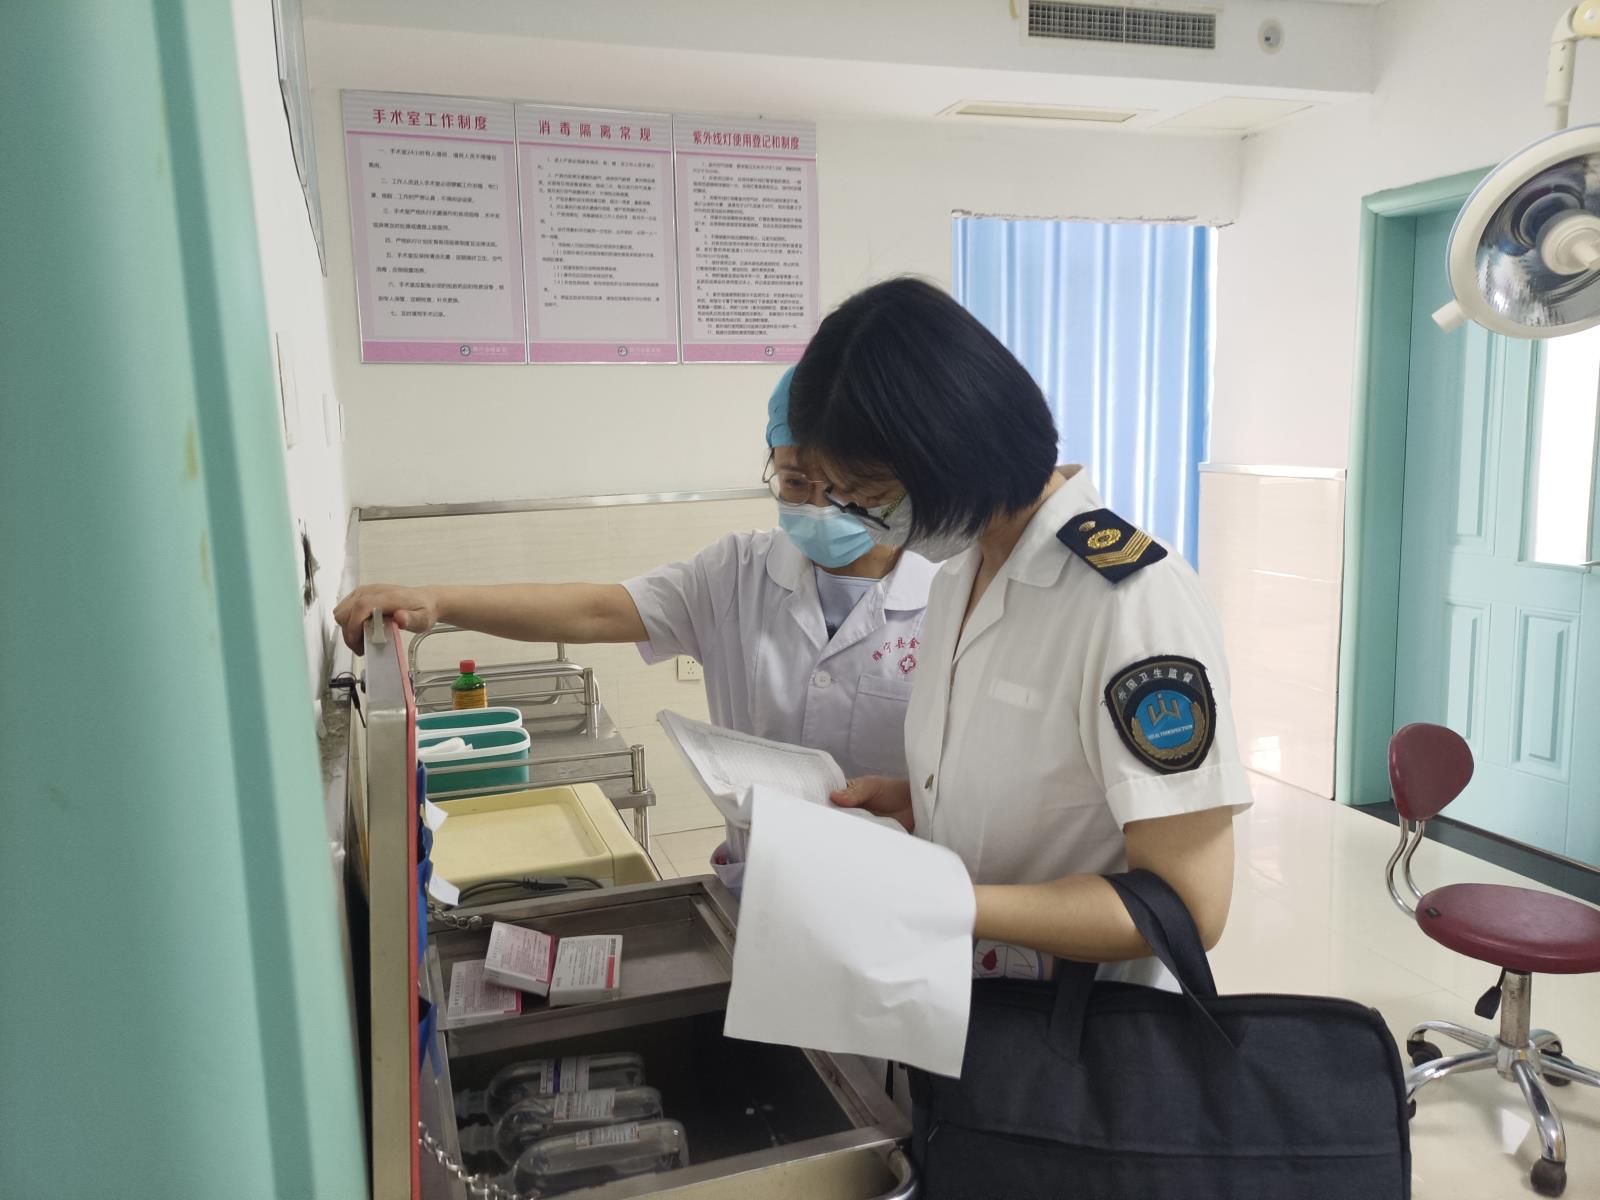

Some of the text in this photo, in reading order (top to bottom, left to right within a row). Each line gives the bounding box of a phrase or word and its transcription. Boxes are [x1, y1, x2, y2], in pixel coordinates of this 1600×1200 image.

[373, 108, 488, 131] 手术室工作制度
[538, 119, 652, 142] 消毒隔离常规
[692, 129, 800, 151] 紫外线灯使用登记和制度
